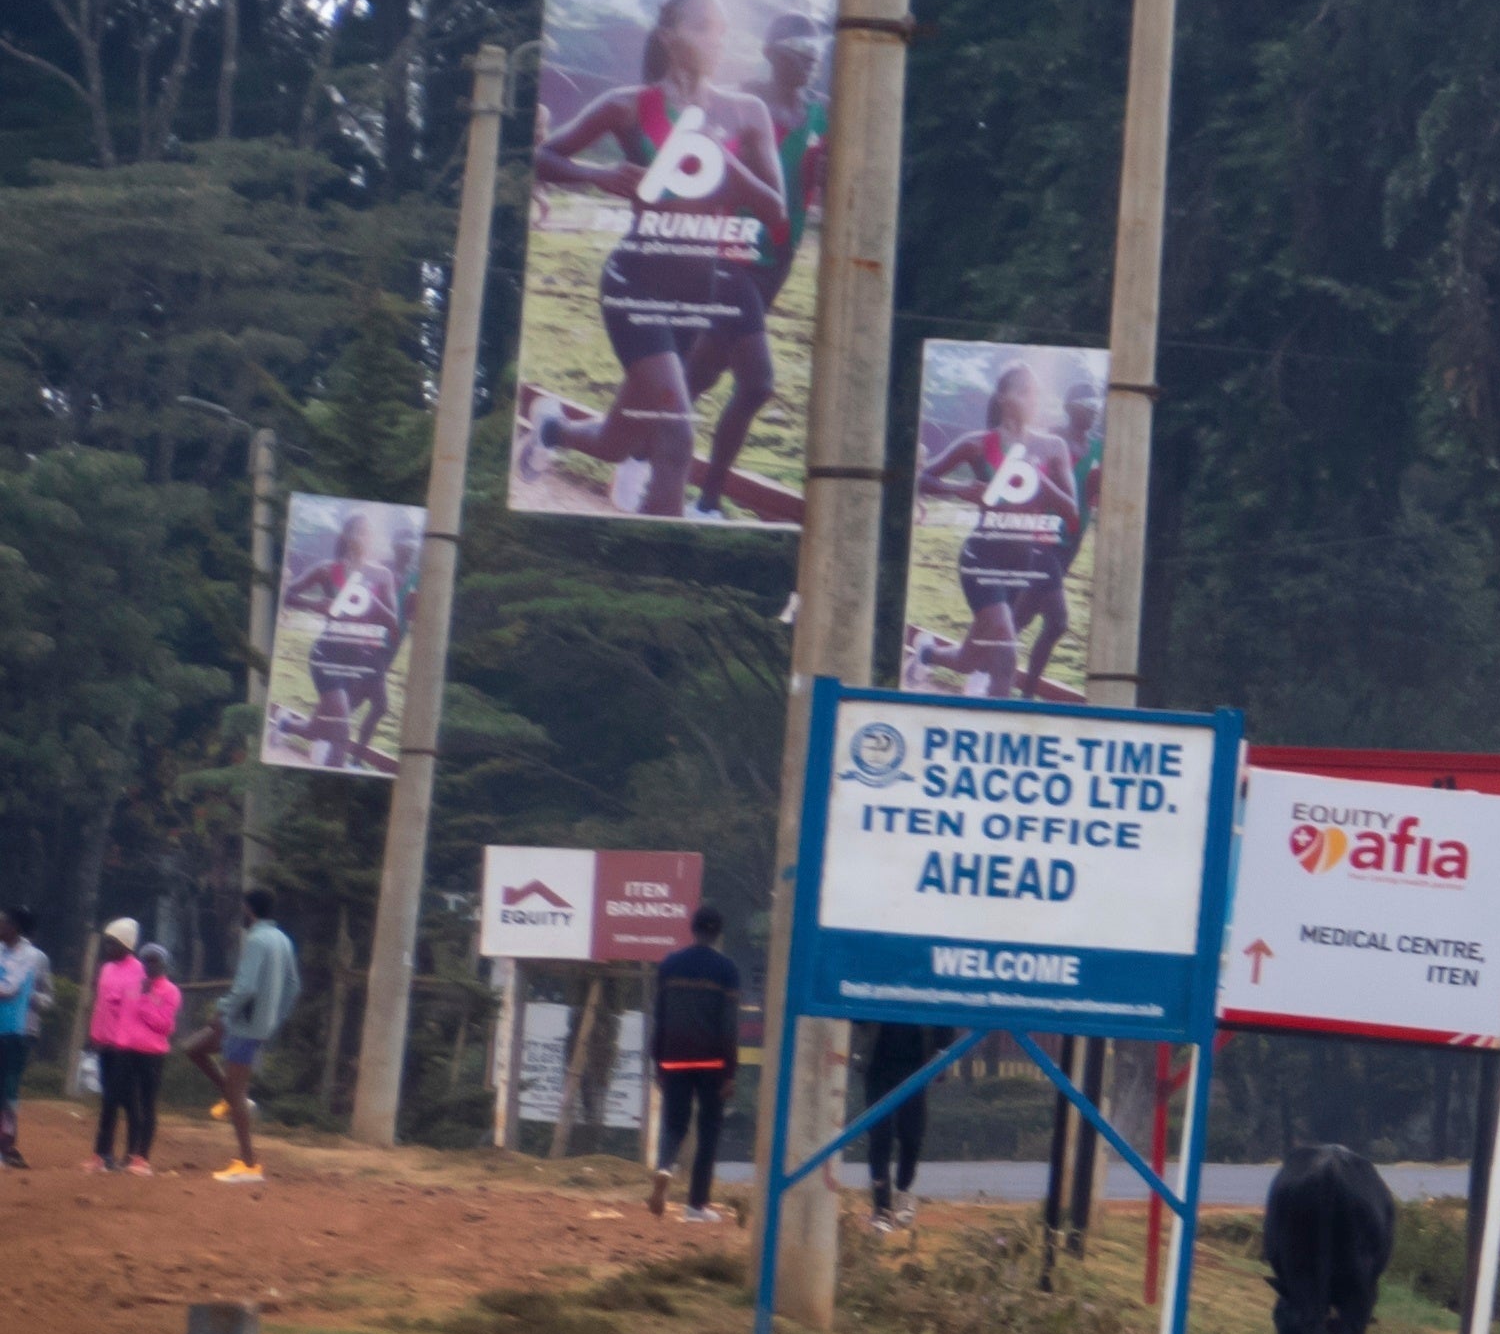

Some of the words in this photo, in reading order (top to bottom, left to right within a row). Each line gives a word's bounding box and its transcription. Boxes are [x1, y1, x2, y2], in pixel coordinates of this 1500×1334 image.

[637, 210, 762, 244] RUNNER
[922, 726, 1183, 778] PRIME-TIME
[922, 763, 1073, 807] SACCO
[1088, 775, 1178, 814] LTD.
[861, 804, 966, 838] ITEN
[981, 813, 1142, 850] OFFICE
[1291, 802, 1395, 829] EQUITY
[624, 880, 671, 898] ITEN
[916, 850, 1077, 902] AHEAD
[500, 909, 574, 928] EQUITY
[605, 899, 688, 919] BRANCH
[1299, 923, 1393, 953] MEDICAL
[931, 945, 1081, 986] WELCOME
[1426, 965, 1480, 988] ITEN
